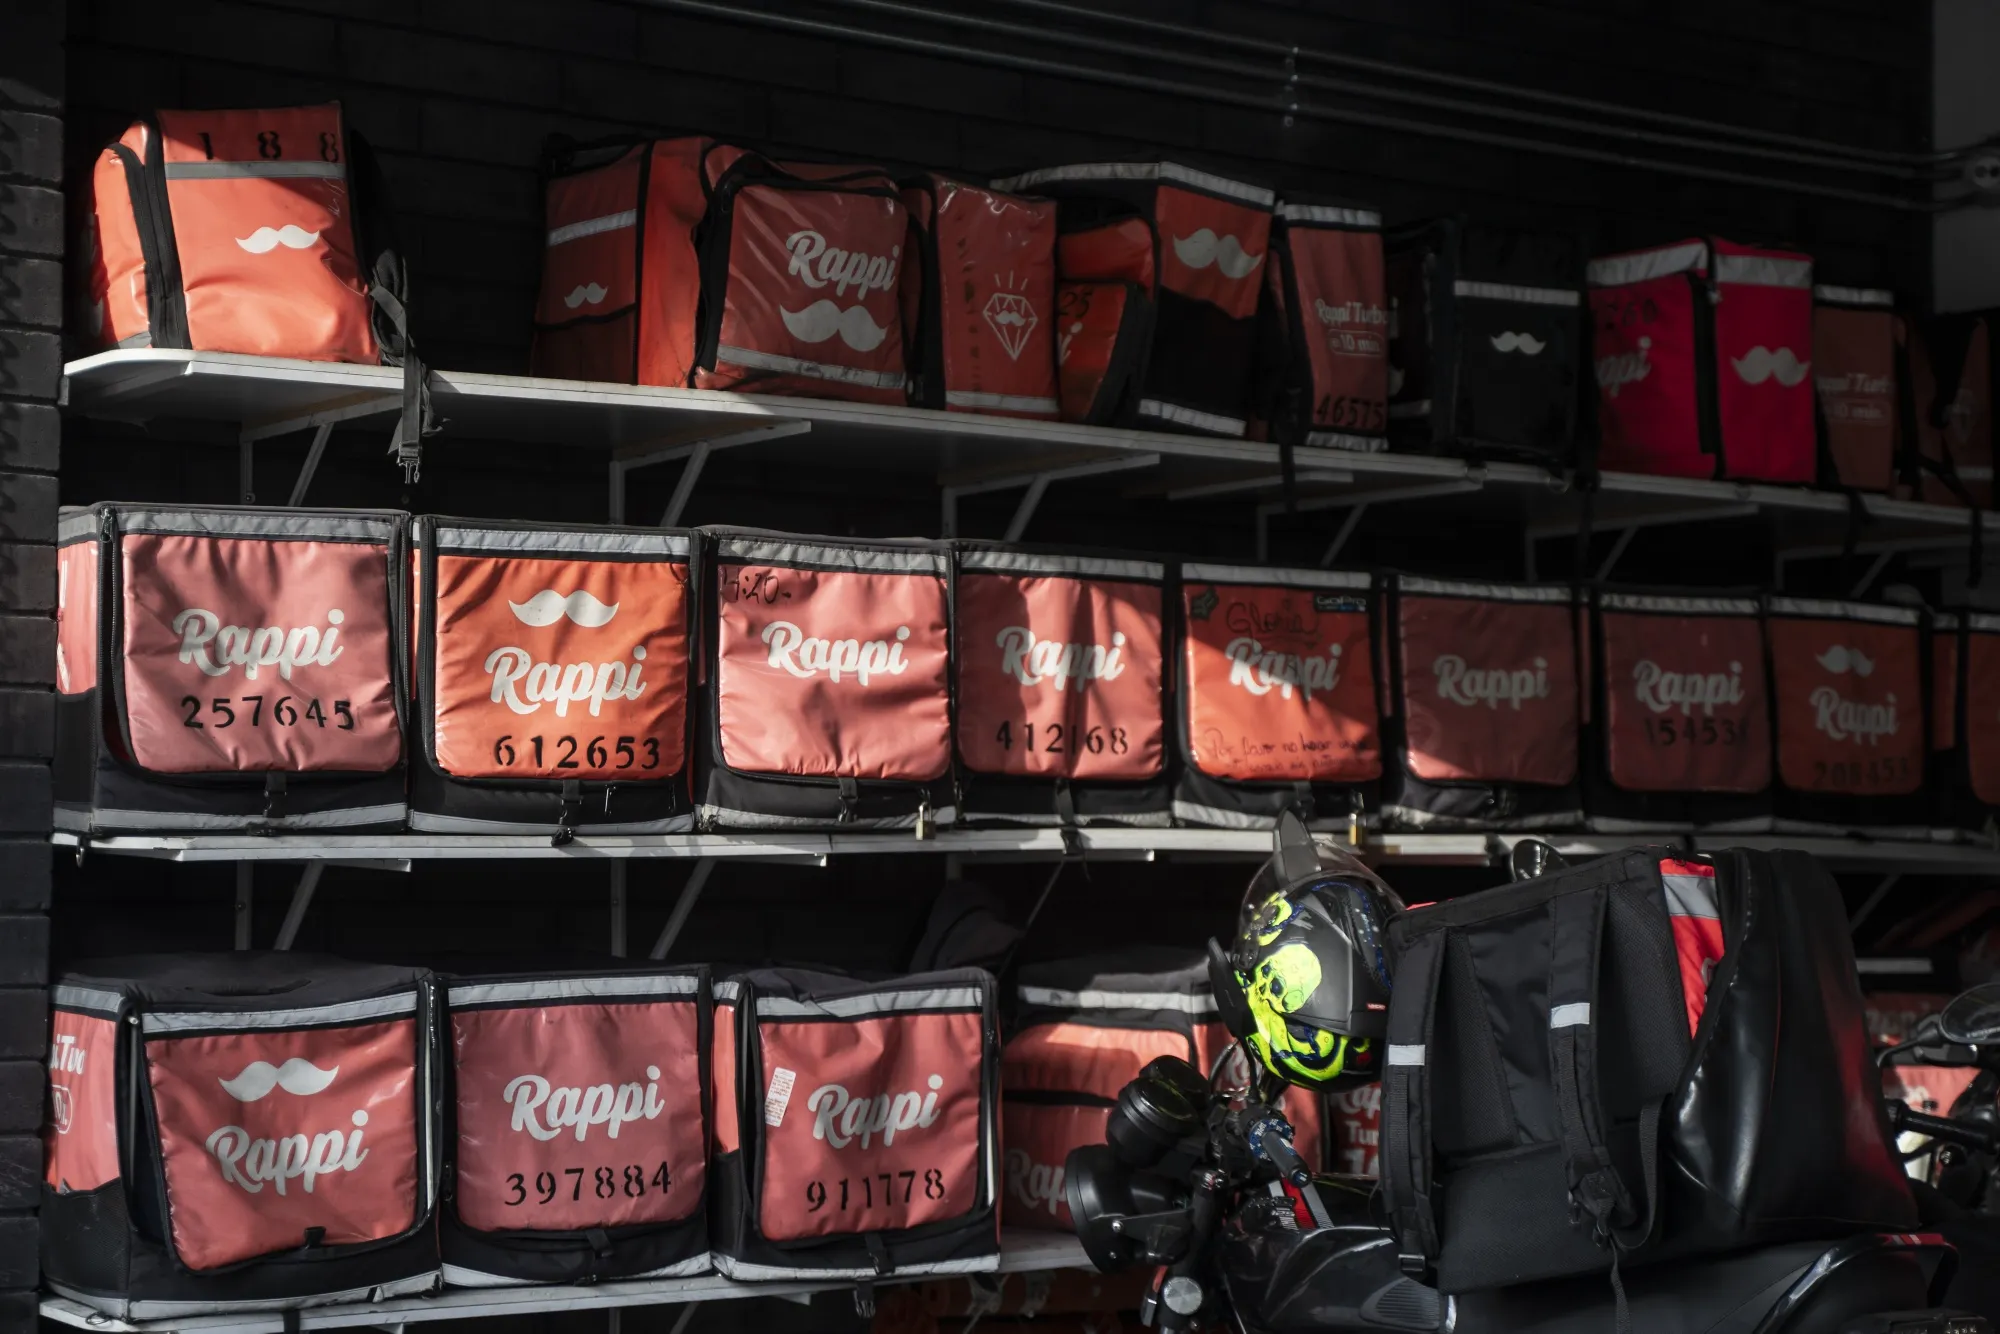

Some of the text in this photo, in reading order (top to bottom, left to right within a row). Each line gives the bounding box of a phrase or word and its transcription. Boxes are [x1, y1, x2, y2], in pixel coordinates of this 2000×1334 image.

[785, 230, 900, 299] Rappi
[172, 608, 345, 680] Rappi
[761, 620, 911, 686] Rappi
[996, 626, 1126, 693] Rappi
[1225, 637, 1343, 701] Rappi
[484, 644, 647, 716] Rappi
[1433, 654, 1552, 710] Rappi
[1632, 659, 1745, 716] Rappi
[181, 695, 356, 731] 257645
[996, 720, 1128, 755] 412168
[1809, 686, 1900, 746] Rappi
[494, 734, 662, 770] 612653
[503, 1065, 665, 1143] Rappi
[807, 1074, 944, 1150] Rappi
[1345, 1121, 1379, 1145] Tur
[205, 1109, 369, 1196] Rappi
[505, 1161, 672, 1206] 397884
[1004, 1148, 1067, 1216] Rap
[806, 1168, 946, 1214] 911778
